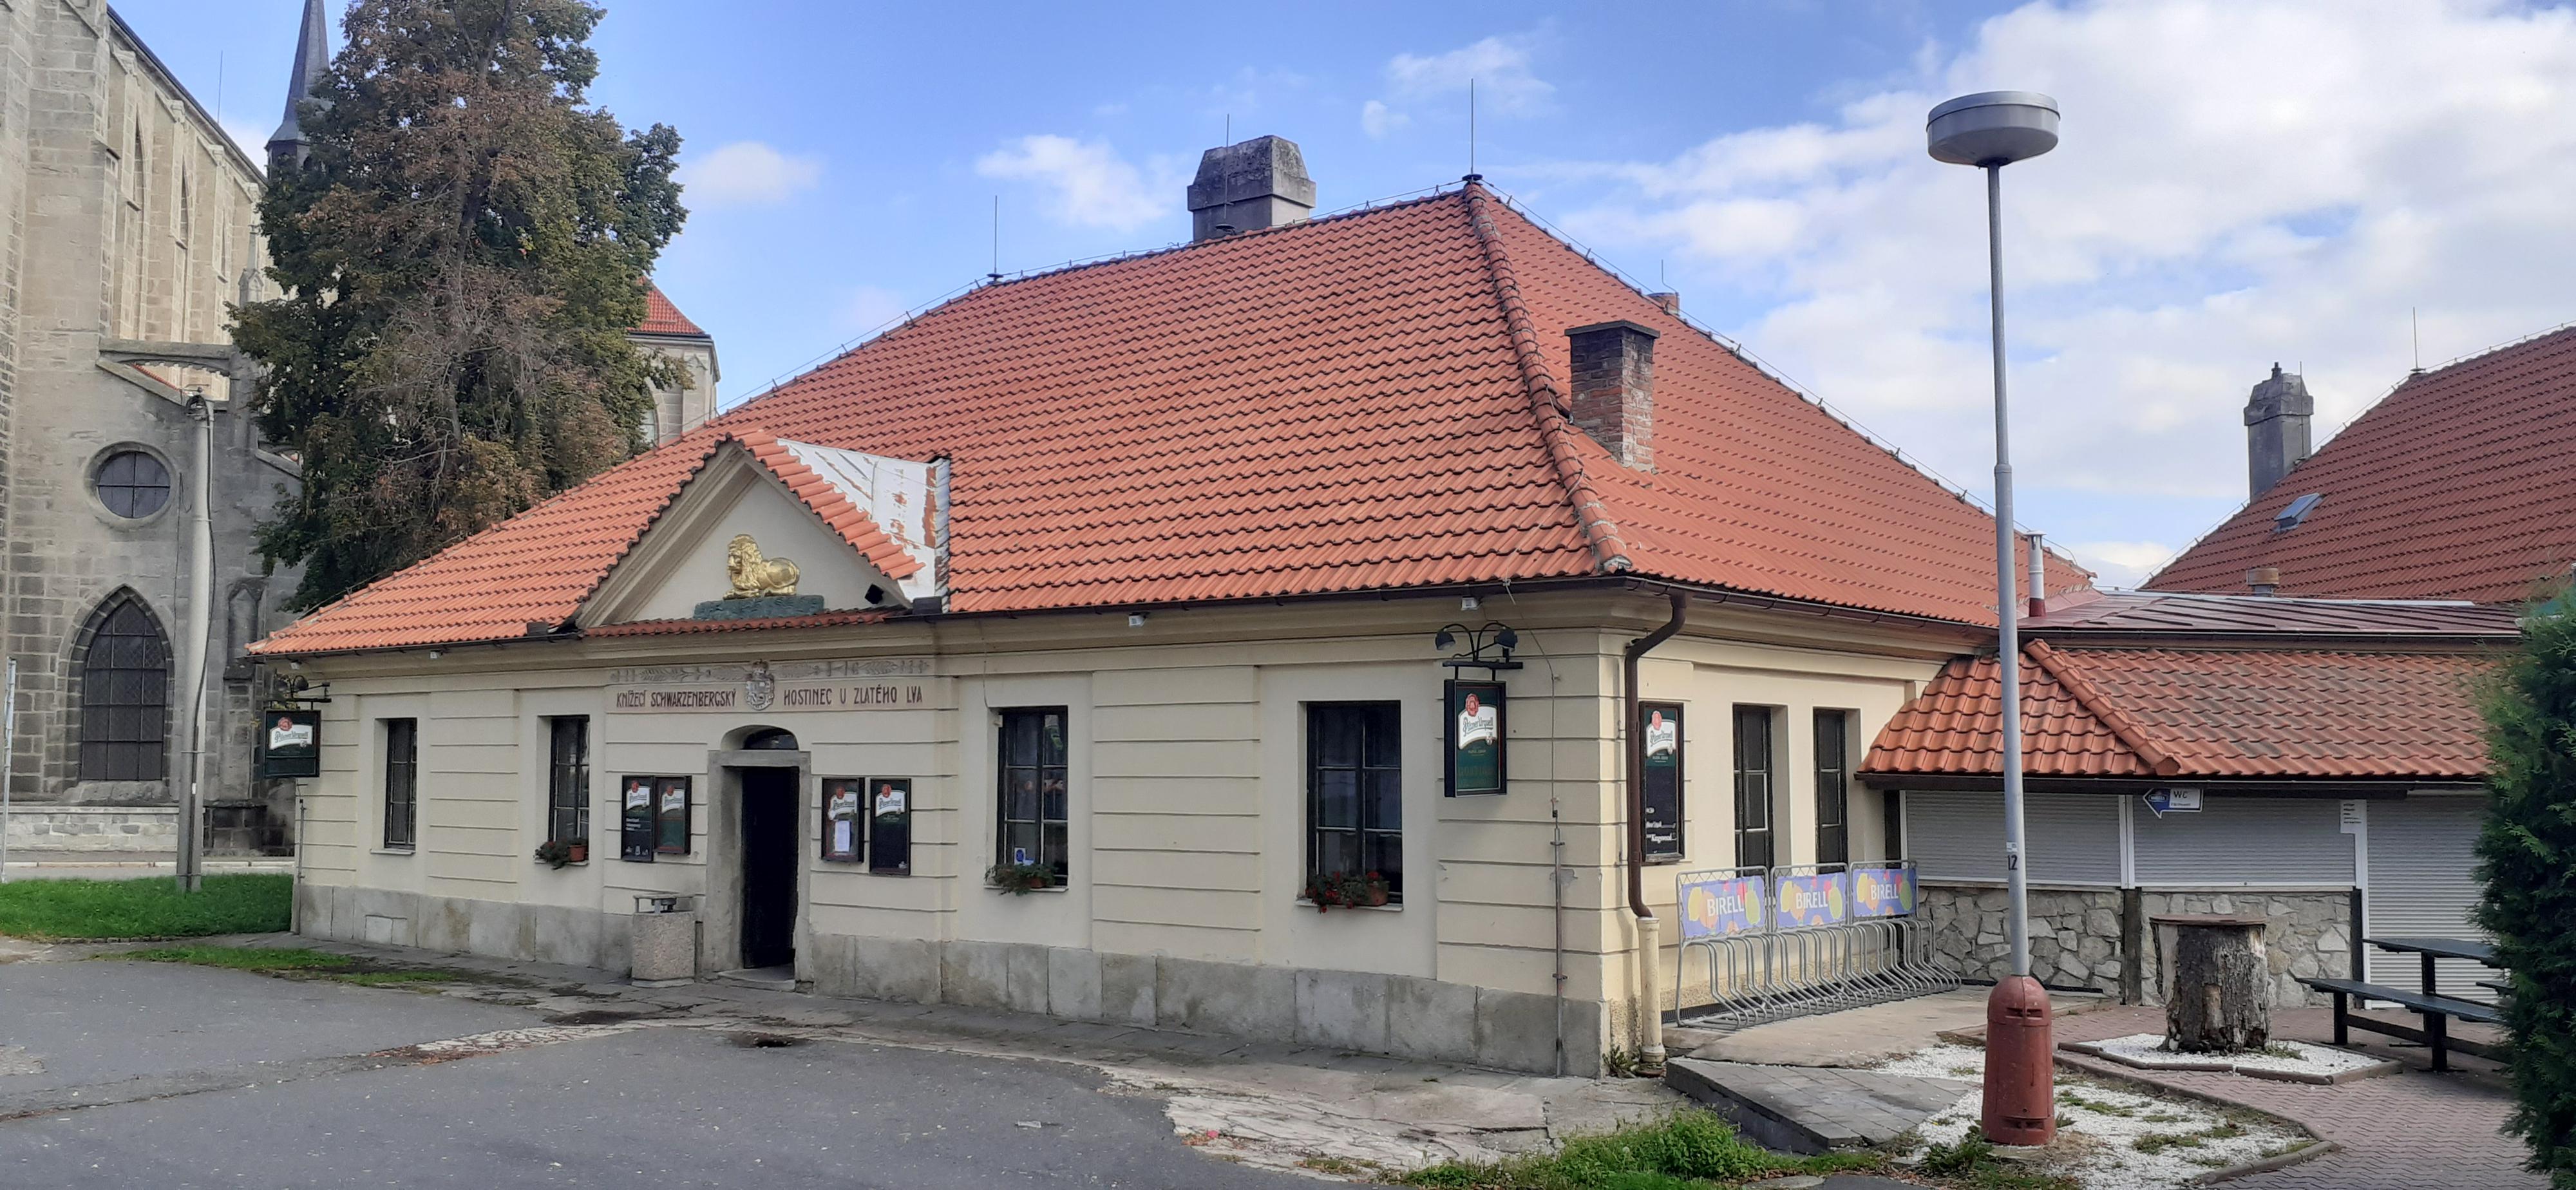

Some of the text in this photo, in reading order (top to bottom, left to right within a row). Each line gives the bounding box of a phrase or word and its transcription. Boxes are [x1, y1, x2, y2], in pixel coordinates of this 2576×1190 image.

[616, 684, 923, 708] KNÍŽECÍ SCHWARZENBERGSKÝ HOSTINEC U ZLATÉHO LVA
[2174, 790, 2188, 798] WC
[2007, 855, 2018, 871] 12
[1795, 891, 1828, 910] BIRELL
[1870, 883, 1899, 900] BIRELL
[1707, 895, 1745, 917] BIRELL
